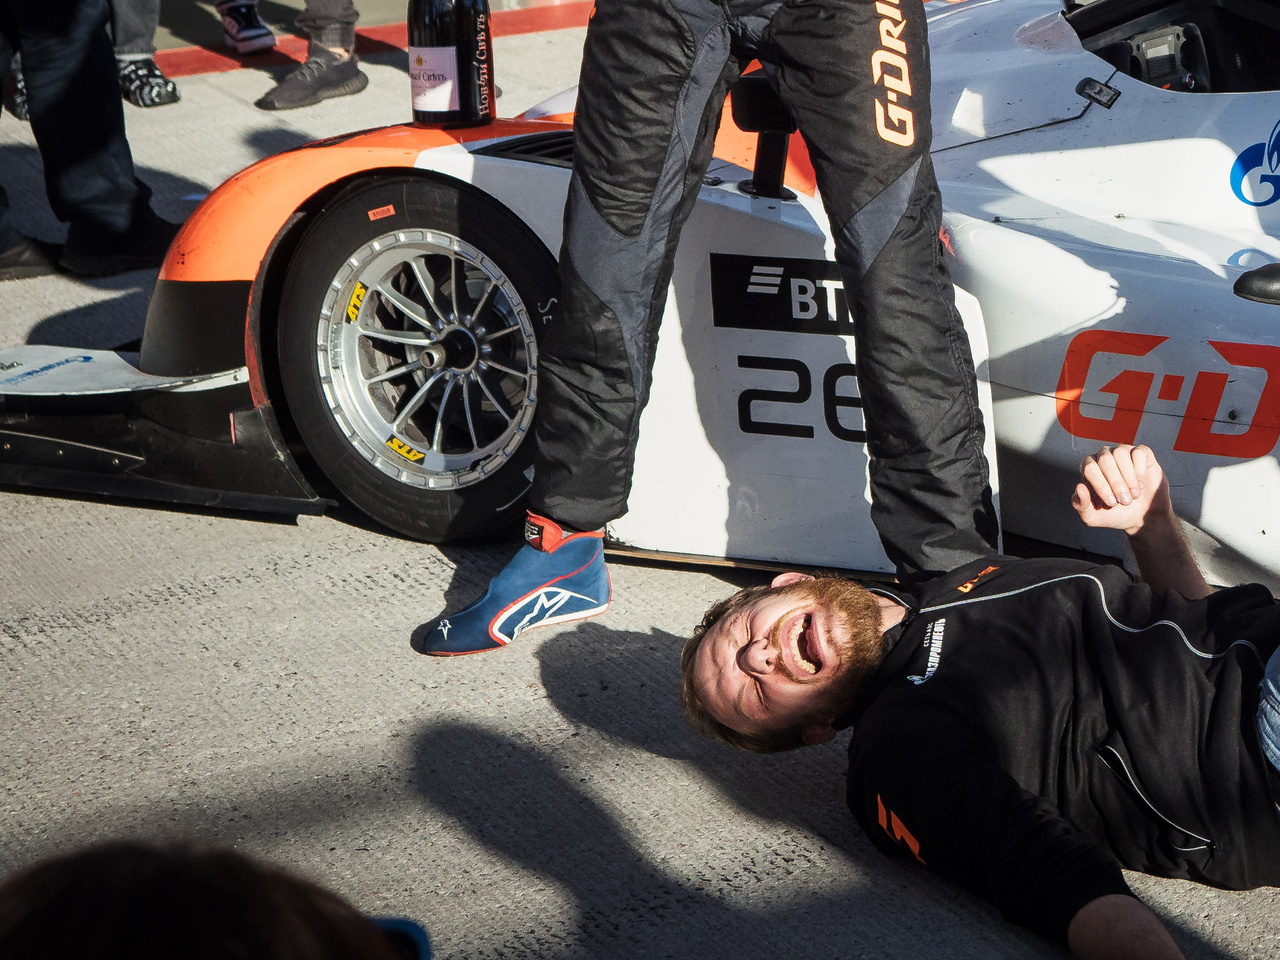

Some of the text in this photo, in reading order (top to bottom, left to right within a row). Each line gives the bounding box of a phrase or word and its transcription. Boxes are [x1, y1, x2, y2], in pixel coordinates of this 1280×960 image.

[346, 281, 368, 322] ATS
[790, 277, 854, 323] ВТ
[385, 436, 425, 462] ATS
